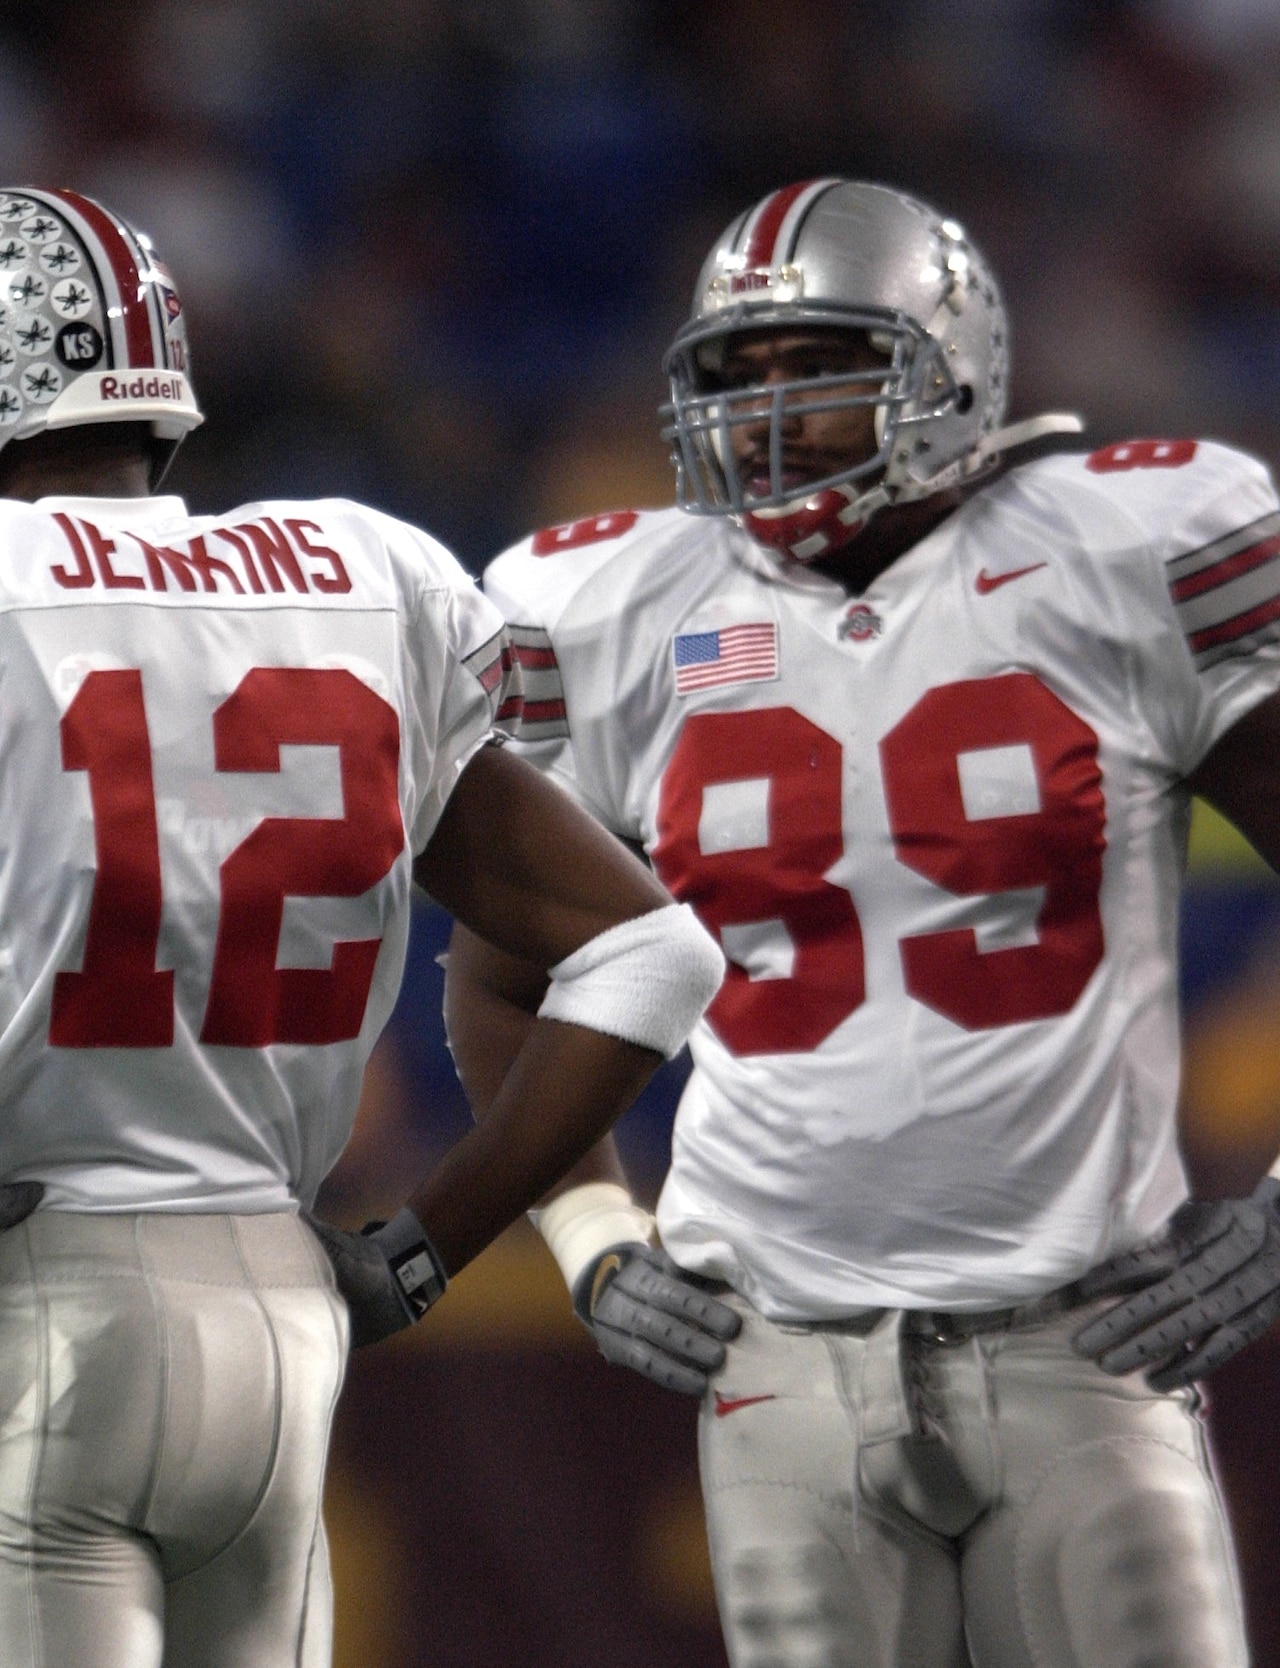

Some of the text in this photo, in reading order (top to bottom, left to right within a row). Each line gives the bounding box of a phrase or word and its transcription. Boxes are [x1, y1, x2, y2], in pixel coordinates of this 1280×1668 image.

[62, 332, 95, 361] KS
[100, 376, 181, 400] Riddell
[50, 512, 352, 594] JENKINS
[48, 667, 406, 1048] 12
[650, 671, 1108, 1058] 89
